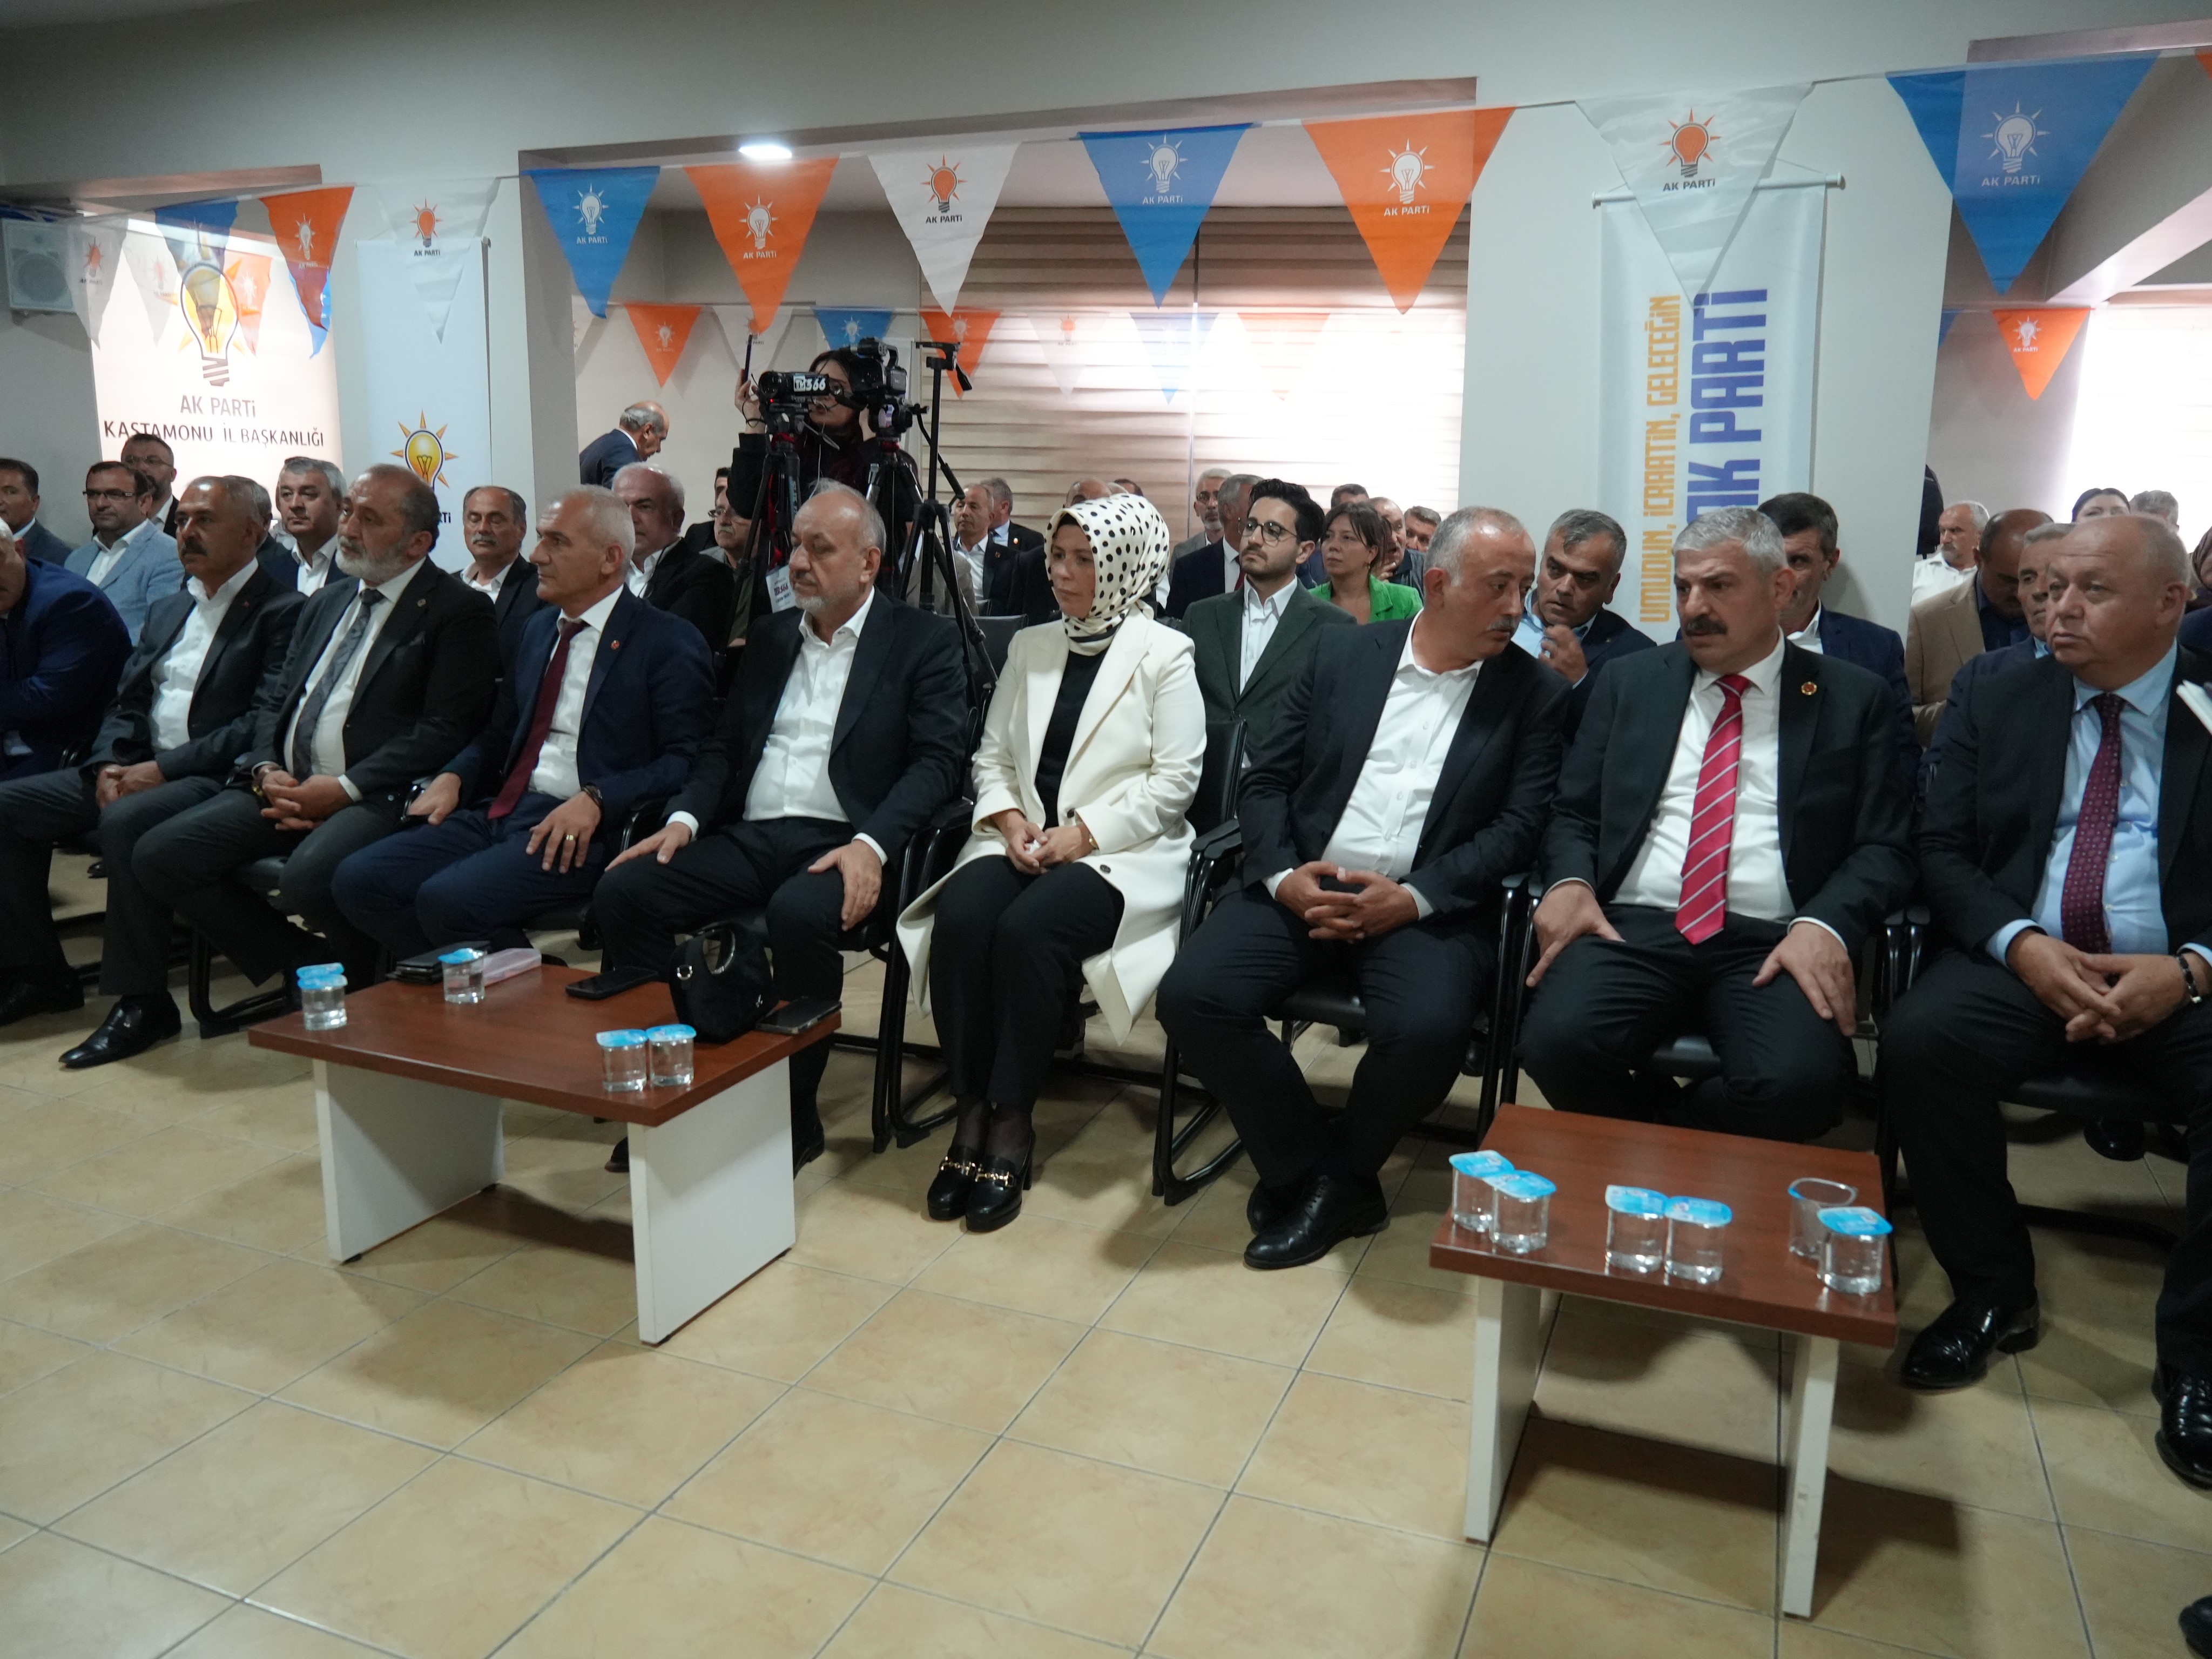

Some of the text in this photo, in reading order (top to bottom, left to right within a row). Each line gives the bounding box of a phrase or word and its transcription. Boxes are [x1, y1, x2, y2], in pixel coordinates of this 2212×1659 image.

[1981, 177, 1999, 186] AK
[1663, 182, 1679, 191] AK
[1142, 196, 1155, 205] AK
[1384, 207, 1398, 216] AK
[743, 251, 754, 259] AK
[180, 395, 204, 415] AK
[104, 420, 213, 441] KASTAMONU
